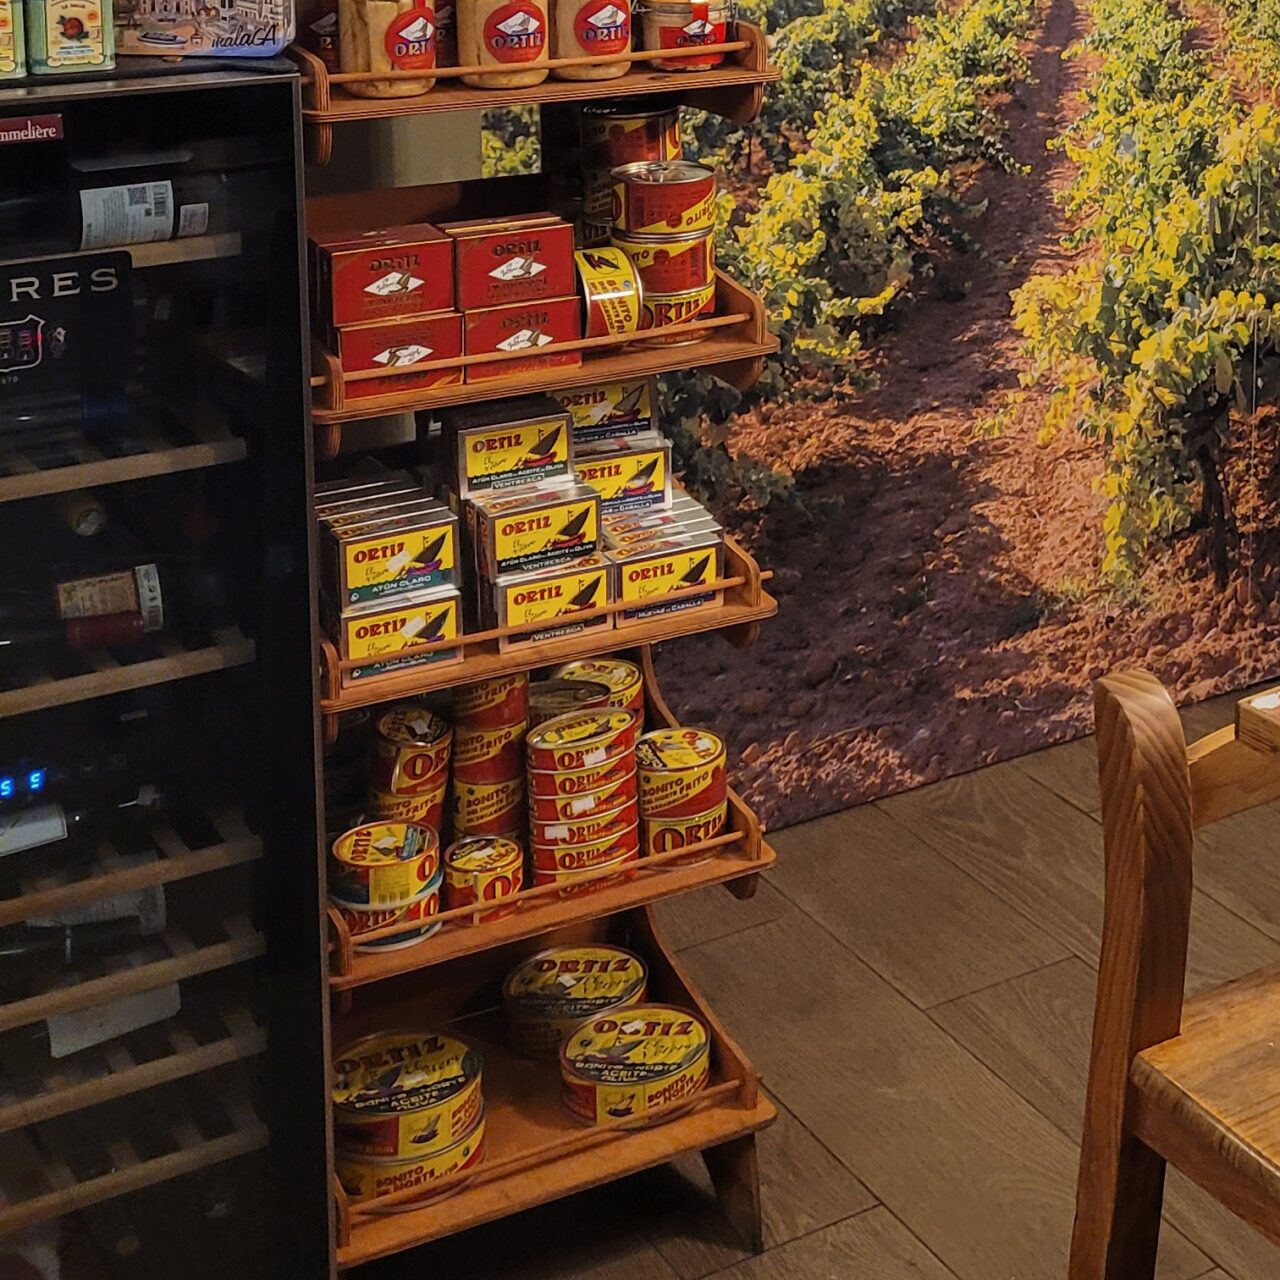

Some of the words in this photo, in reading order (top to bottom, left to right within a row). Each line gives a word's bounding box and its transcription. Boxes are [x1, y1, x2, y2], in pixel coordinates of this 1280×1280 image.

[491, 32, 544, 49] ORTIZ
[563, 390, 608, 408] ORTIZ
[472, 433, 524, 455] ORTIZ
[493, 474, 544, 489] VENTRESCA
[578, 463, 623, 482] ORTIZ
[501, 515, 553, 537] ORTIZ
[521, 555, 573, 571] VENTRESCA
[628, 562, 676, 583] ORTIZ
[371, 581, 398, 593] ATÚN
[399, 574, 432, 588] CLARO
[513, 584, 564, 606] ORTIZ
[532, 624, 583, 641] VENTRESCA
[477, 730, 513, 754] FRITO
[642, 776, 685, 799] BONITO
[678, 770, 710, 796] FRITO
[466, 784, 511, 809] BONITO
[350, 829, 373, 862] ORTIZ
[533, 957, 632, 974] ORTIZ
[335, 1035, 446, 1073] ORTIZ
[575, 1061, 625, 1071] BONITO
[647, 1073, 688, 1105] BONITO
[375, 1164, 425, 1189] BONITO
